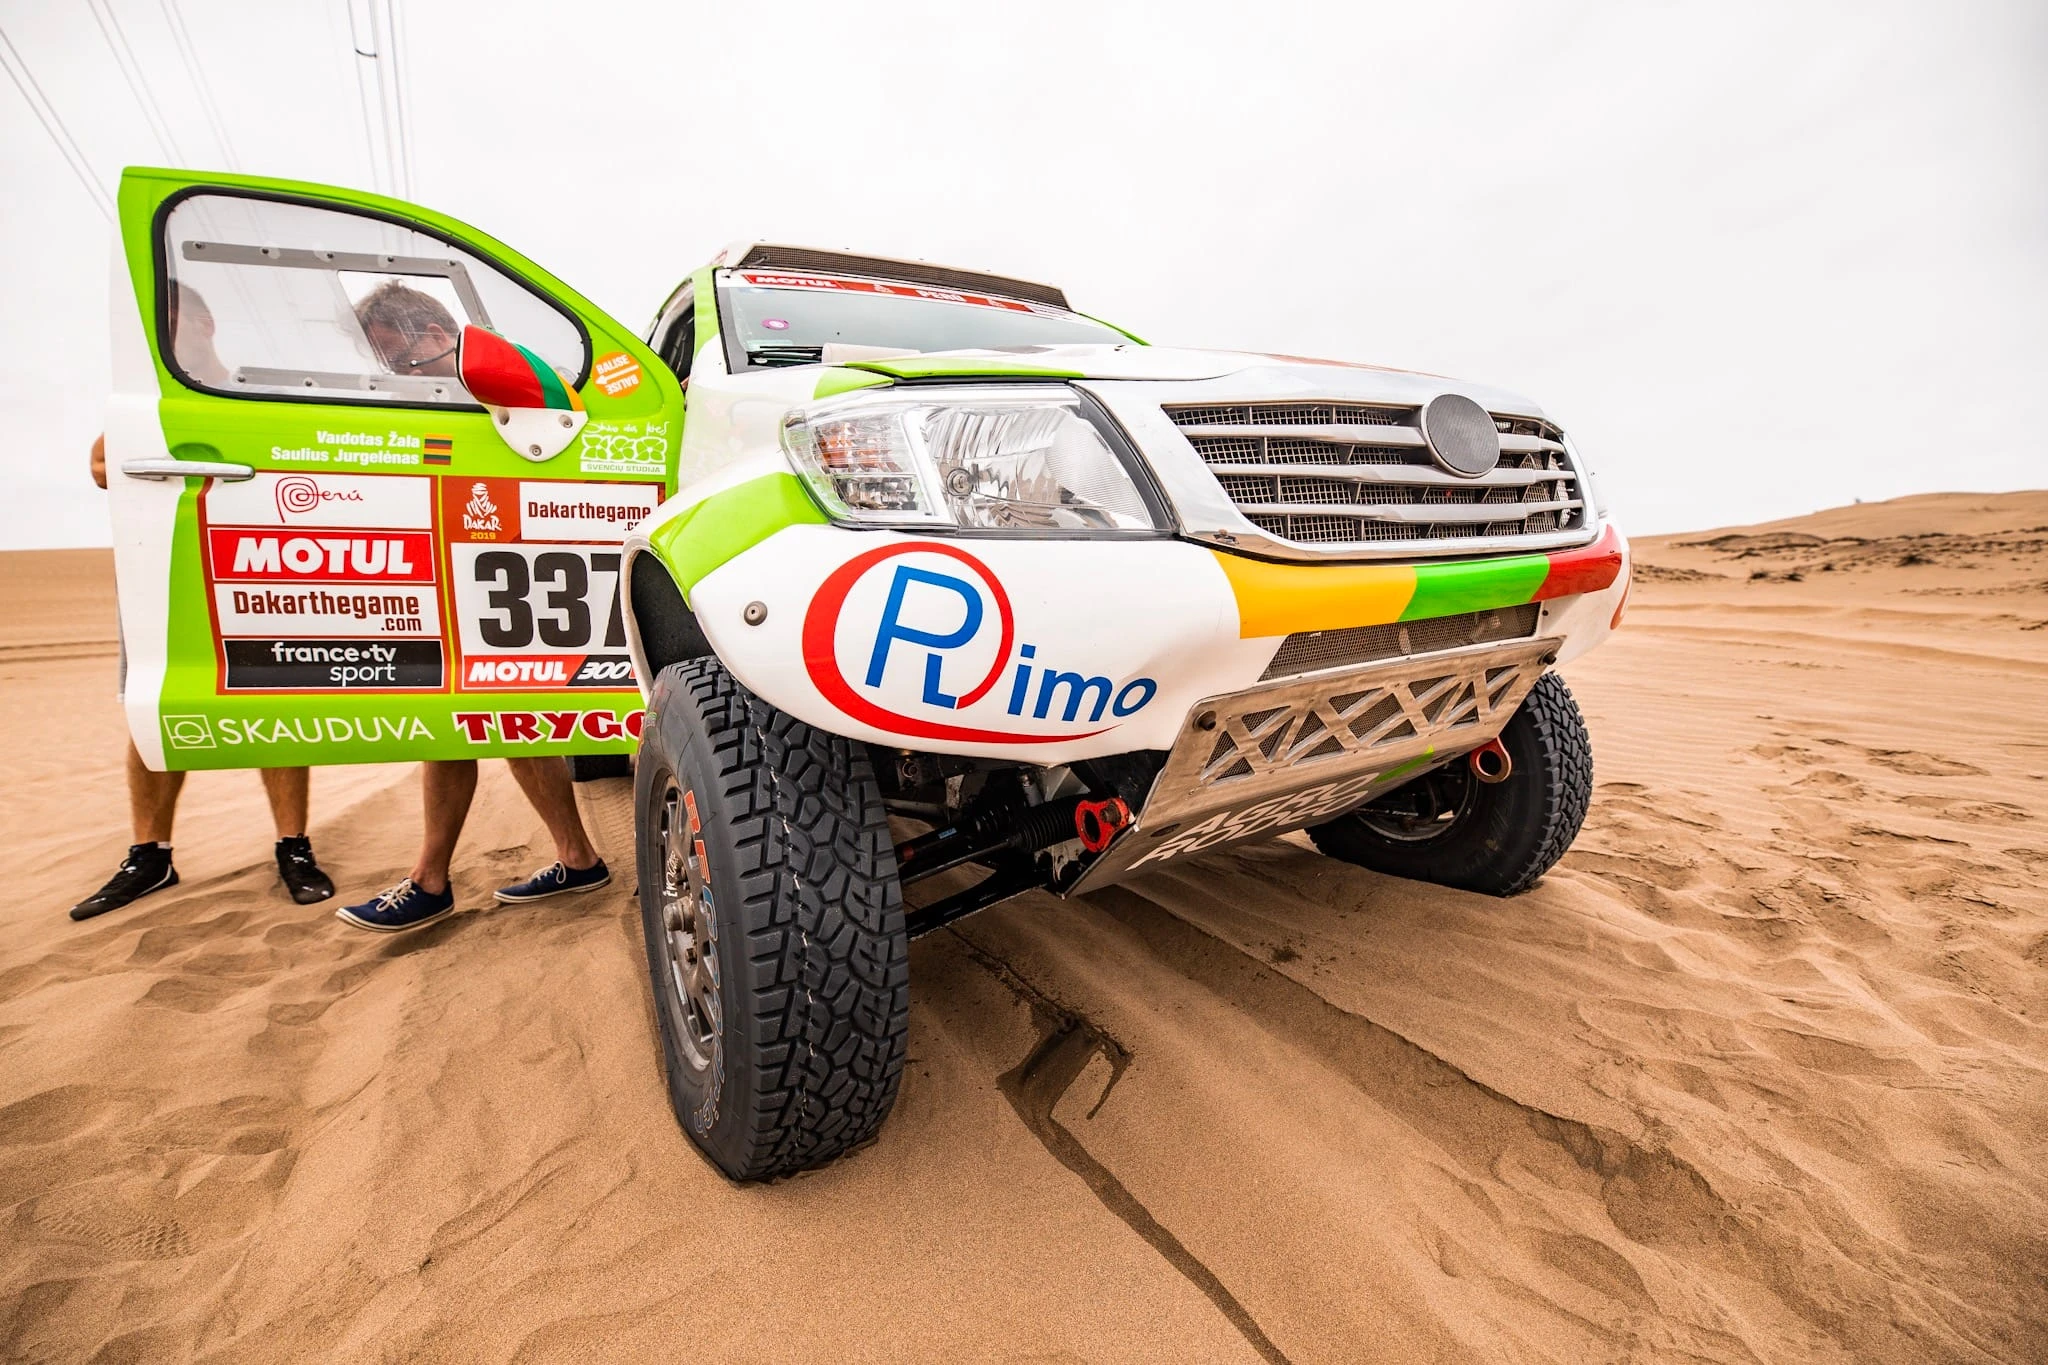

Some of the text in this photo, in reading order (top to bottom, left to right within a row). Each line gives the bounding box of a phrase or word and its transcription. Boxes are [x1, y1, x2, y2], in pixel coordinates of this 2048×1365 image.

[755, 275, 838, 288] MOTUL
[596, 353, 630, 375] BALISE
[604, 374, 639, 395] BALISE
[316, 430, 420, 449] Vaidotas Žala
[271, 446, 329, 462] Saulius
[625, 464, 661, 473] STUDIJA
[528, 501, 651, 523] Dakarthegame
[470, 531, 497, 540] 2019
[232, 536, 414, 576] MOTUL
[232, 590, 420, 620] Dakarthegame
[474, 550, 628, 648] 337
[380, 617, 422, 632] .com
[329, 663, 396, 687] sport
[468, 660, 636, 683] MOTUL 300
[217, 716, 435, 744] SKAUDUVA
